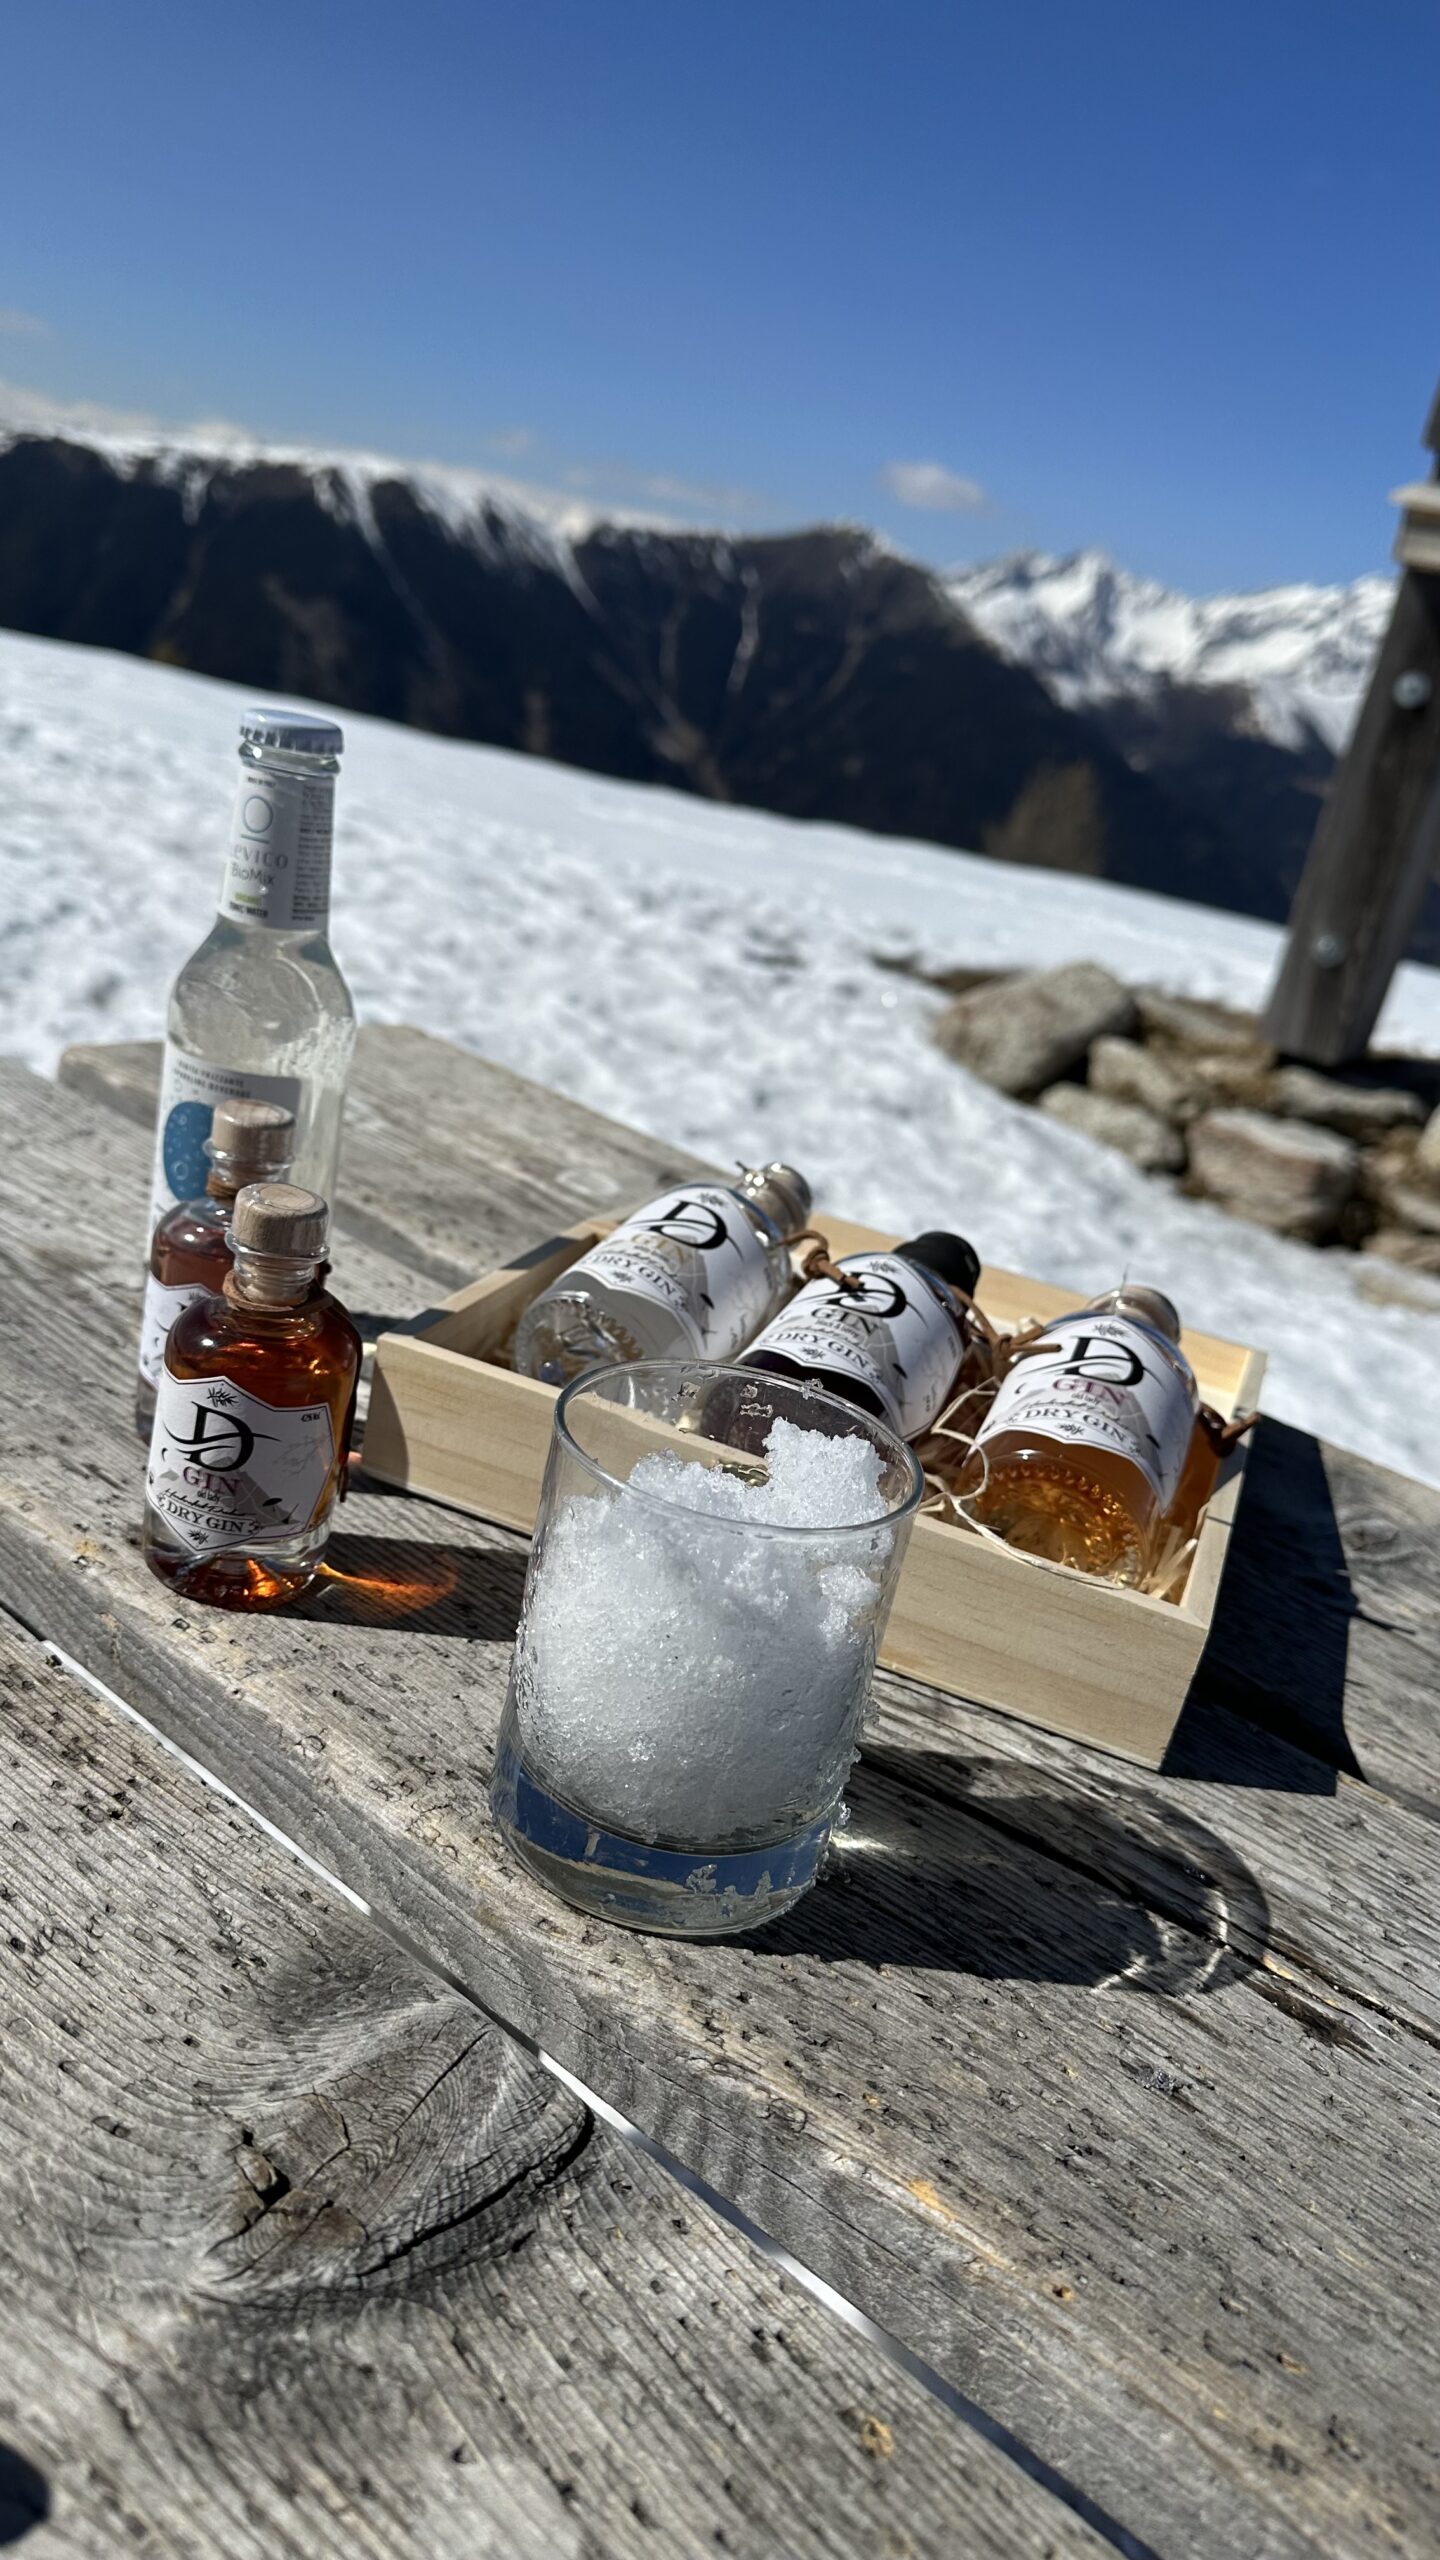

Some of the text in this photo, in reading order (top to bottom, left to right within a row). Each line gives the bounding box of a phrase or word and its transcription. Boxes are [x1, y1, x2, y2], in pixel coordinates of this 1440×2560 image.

[593, 1254, 640, 1269] DRY
[638, 1265, 677, 1296] GIN
[811, 1306, 880, 1336] GIN
[776, 1331, 824, 1347] DRY
[827, 1340, 869, 1369] GIN
[1052, 1377, 1128, 1405] GIN
[1025, 1406, 1080, 1421] DRY
[1082, 1414, 1128, 1443] GIN
[182, 1465, 244, 1497] GIN
[166, 1500, 245, 1533] DRY GIN
